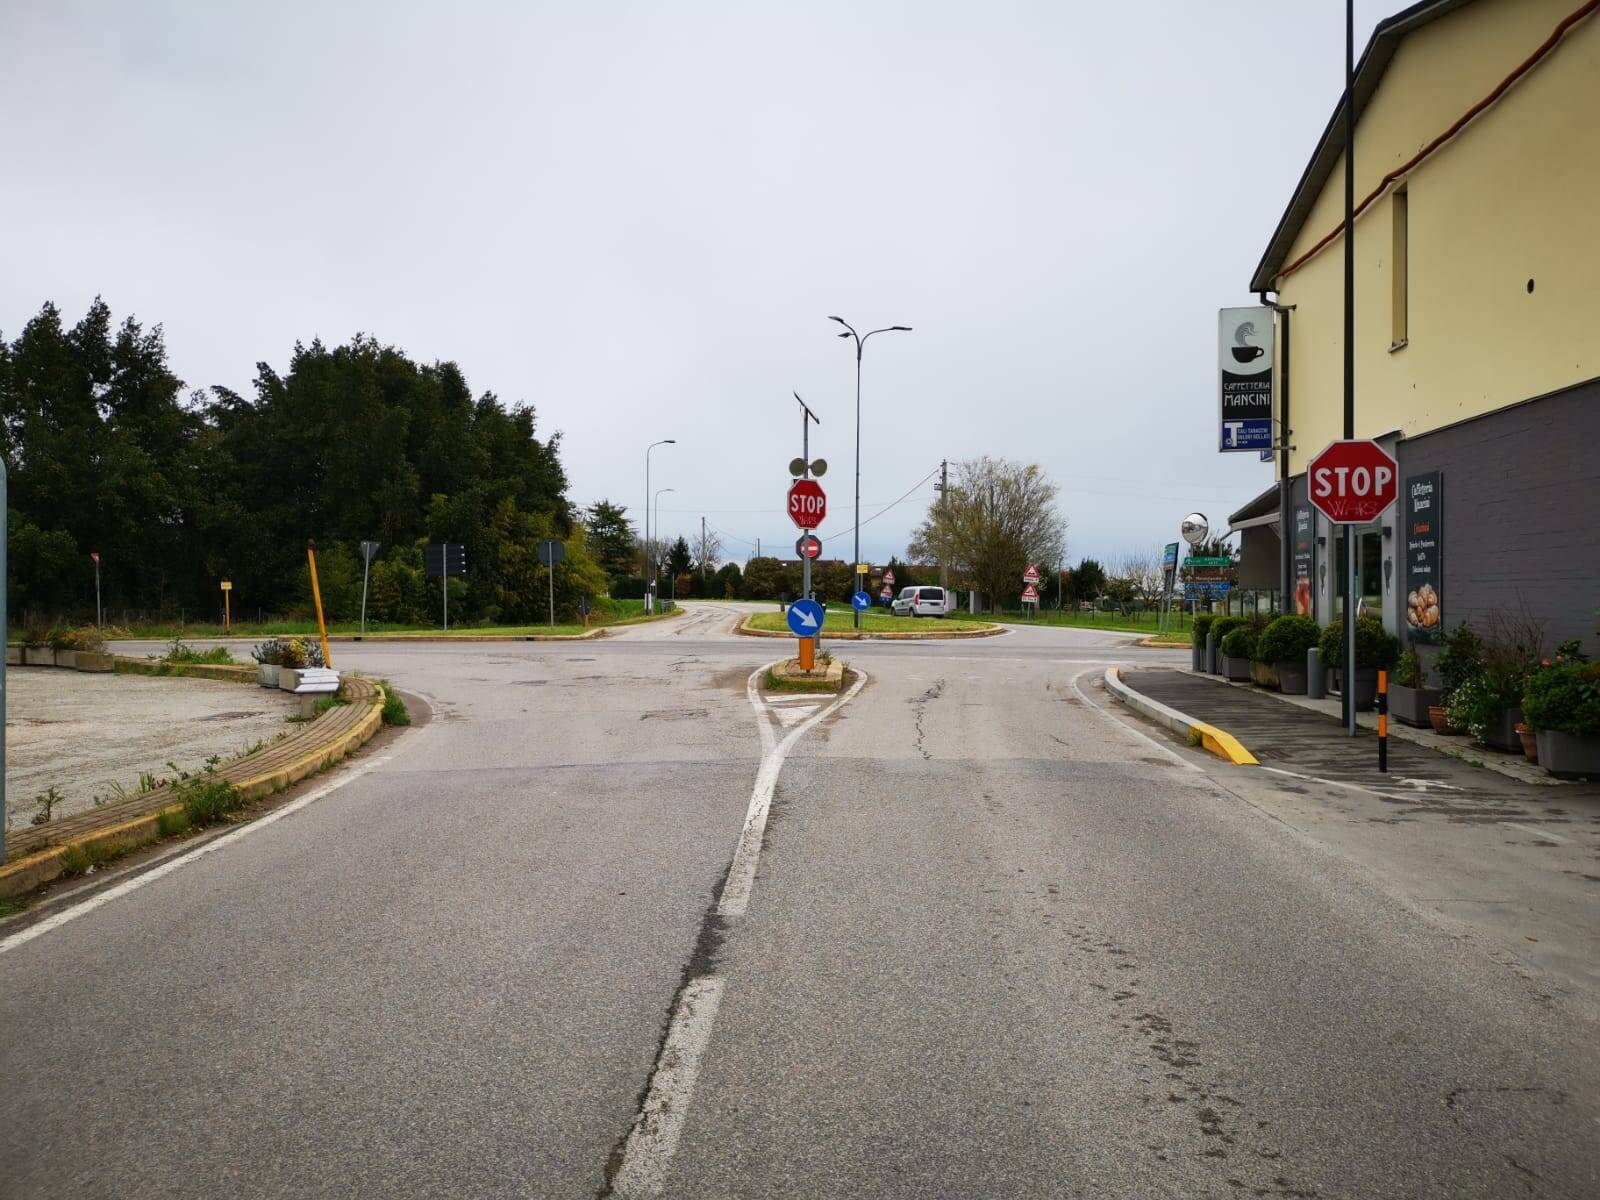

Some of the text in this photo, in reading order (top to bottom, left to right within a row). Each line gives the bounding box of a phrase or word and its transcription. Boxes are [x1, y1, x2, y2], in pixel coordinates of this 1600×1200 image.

[1224, 382, 1270, 391] CAFFETTERIA
[1224, 393, 1270, 407] MANCINI
[1315, 466, 1392, 497] STOP
[791, 494, 824, 514] STOP
